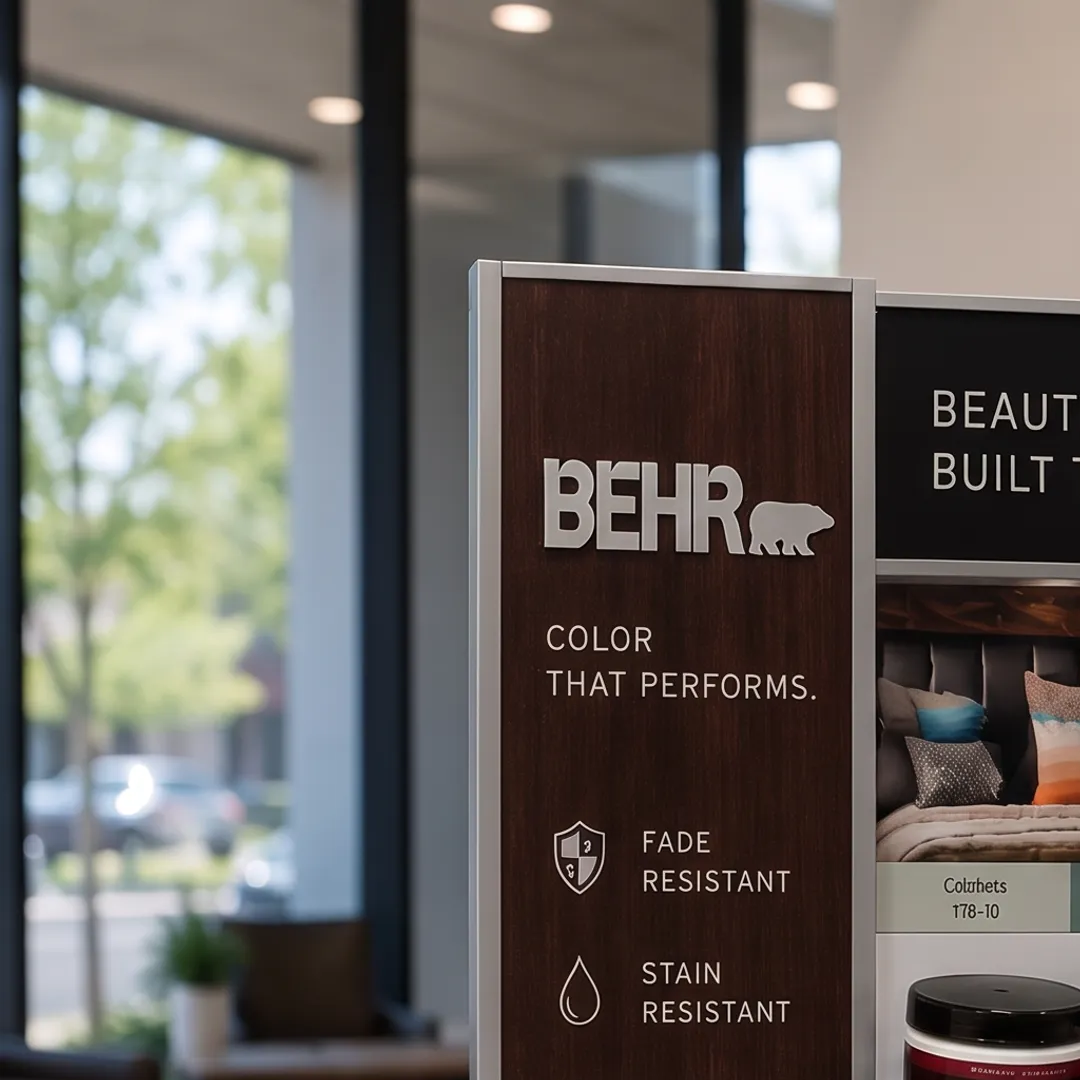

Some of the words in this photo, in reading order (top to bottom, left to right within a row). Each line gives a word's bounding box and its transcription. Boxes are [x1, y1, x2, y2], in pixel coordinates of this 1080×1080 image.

[933, 452, 1053, 493] BUILT
[543, 458, 746, 555] BEHR
[546, 624, 652, 652] COLOR
[546, 670, 627, 697] THAT
[641, 672, 817, 700] PERFORMS.
[643, 830, 711, 853] FADE
[643, 870, 791, 893] RESISTANT
[642, 961, 722, 985] STAIN
[643, 1000, 791, 1023] RESISTANT
